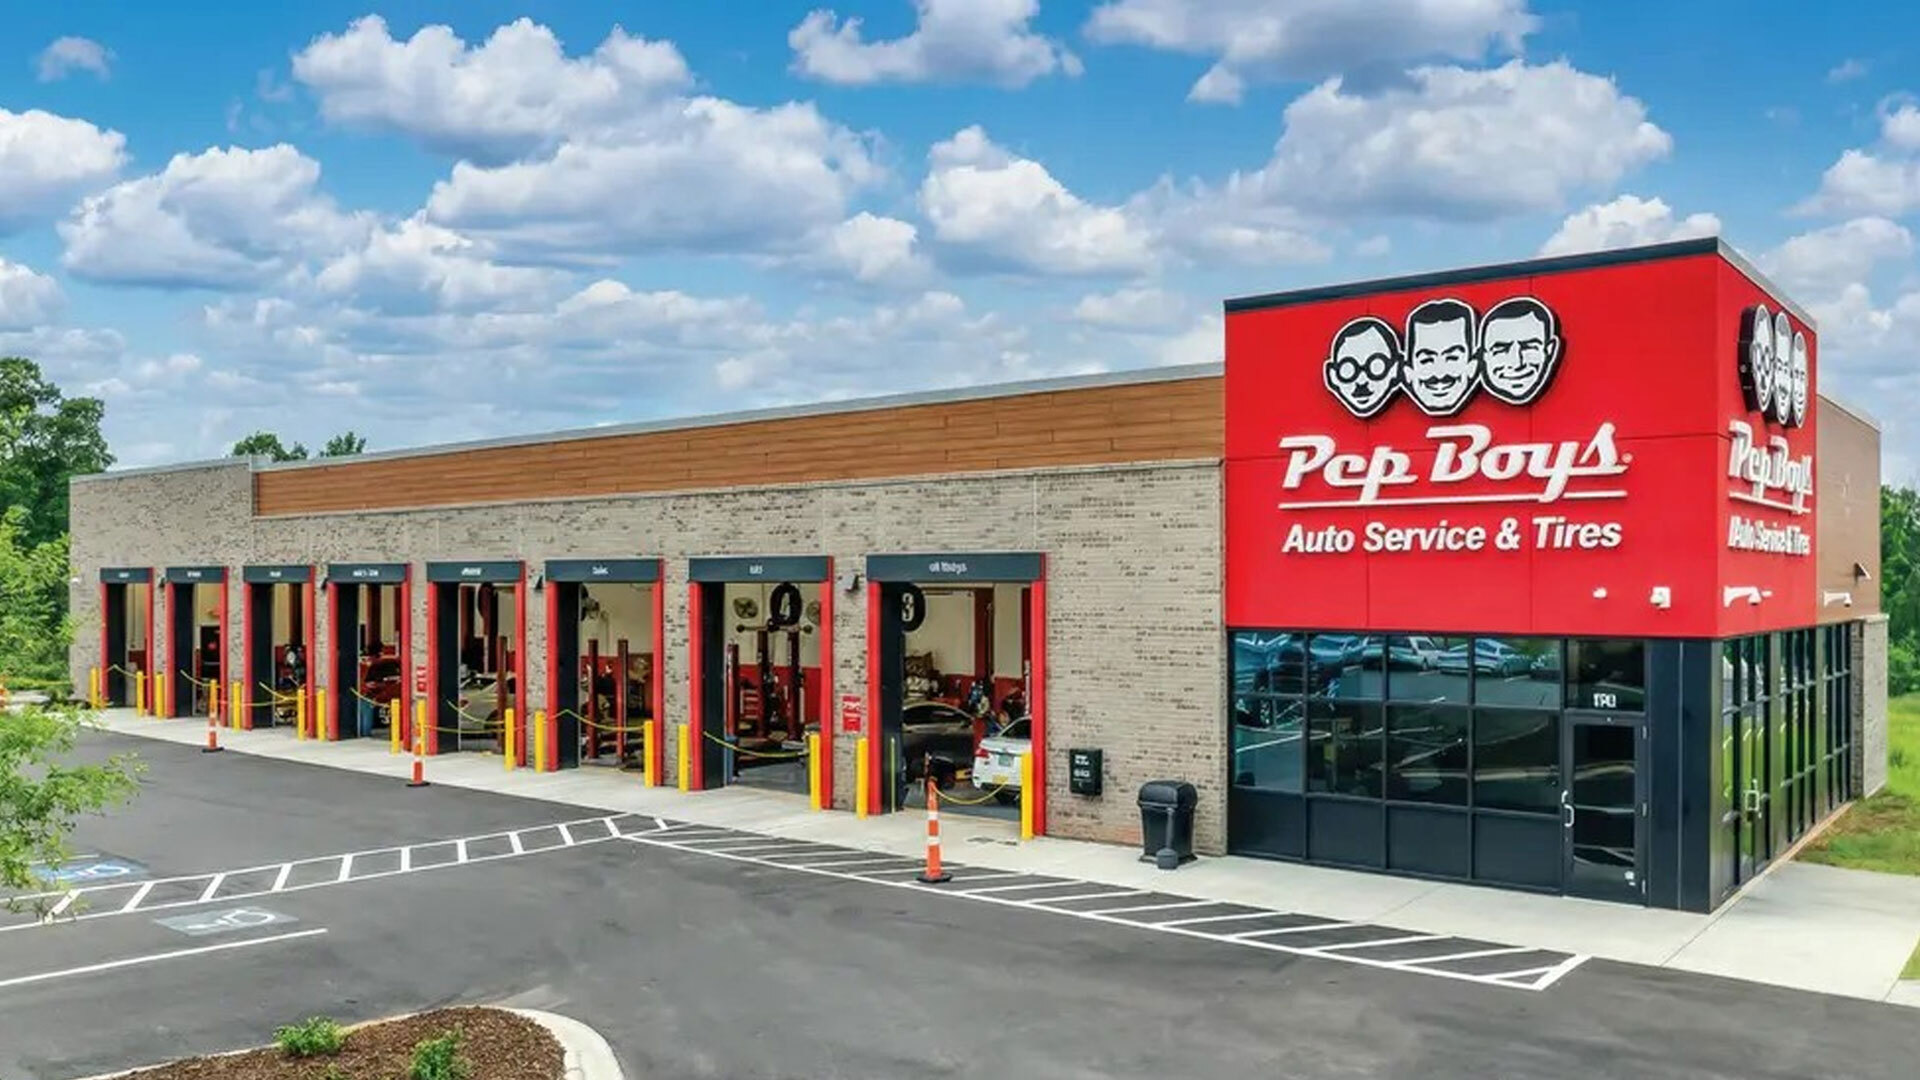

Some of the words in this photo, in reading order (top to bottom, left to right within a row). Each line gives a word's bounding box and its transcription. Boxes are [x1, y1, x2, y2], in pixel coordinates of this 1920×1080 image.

[1279, 435, 1418, 504] Pep
[1728, 420, 1771, 500] Pep
[1282, 524, 1355, 552] Auto
[1363, 520, 1486, 551] Service
[1495, 517, 1521, 549] &
[1532, 516, 1622, 548] Tires
